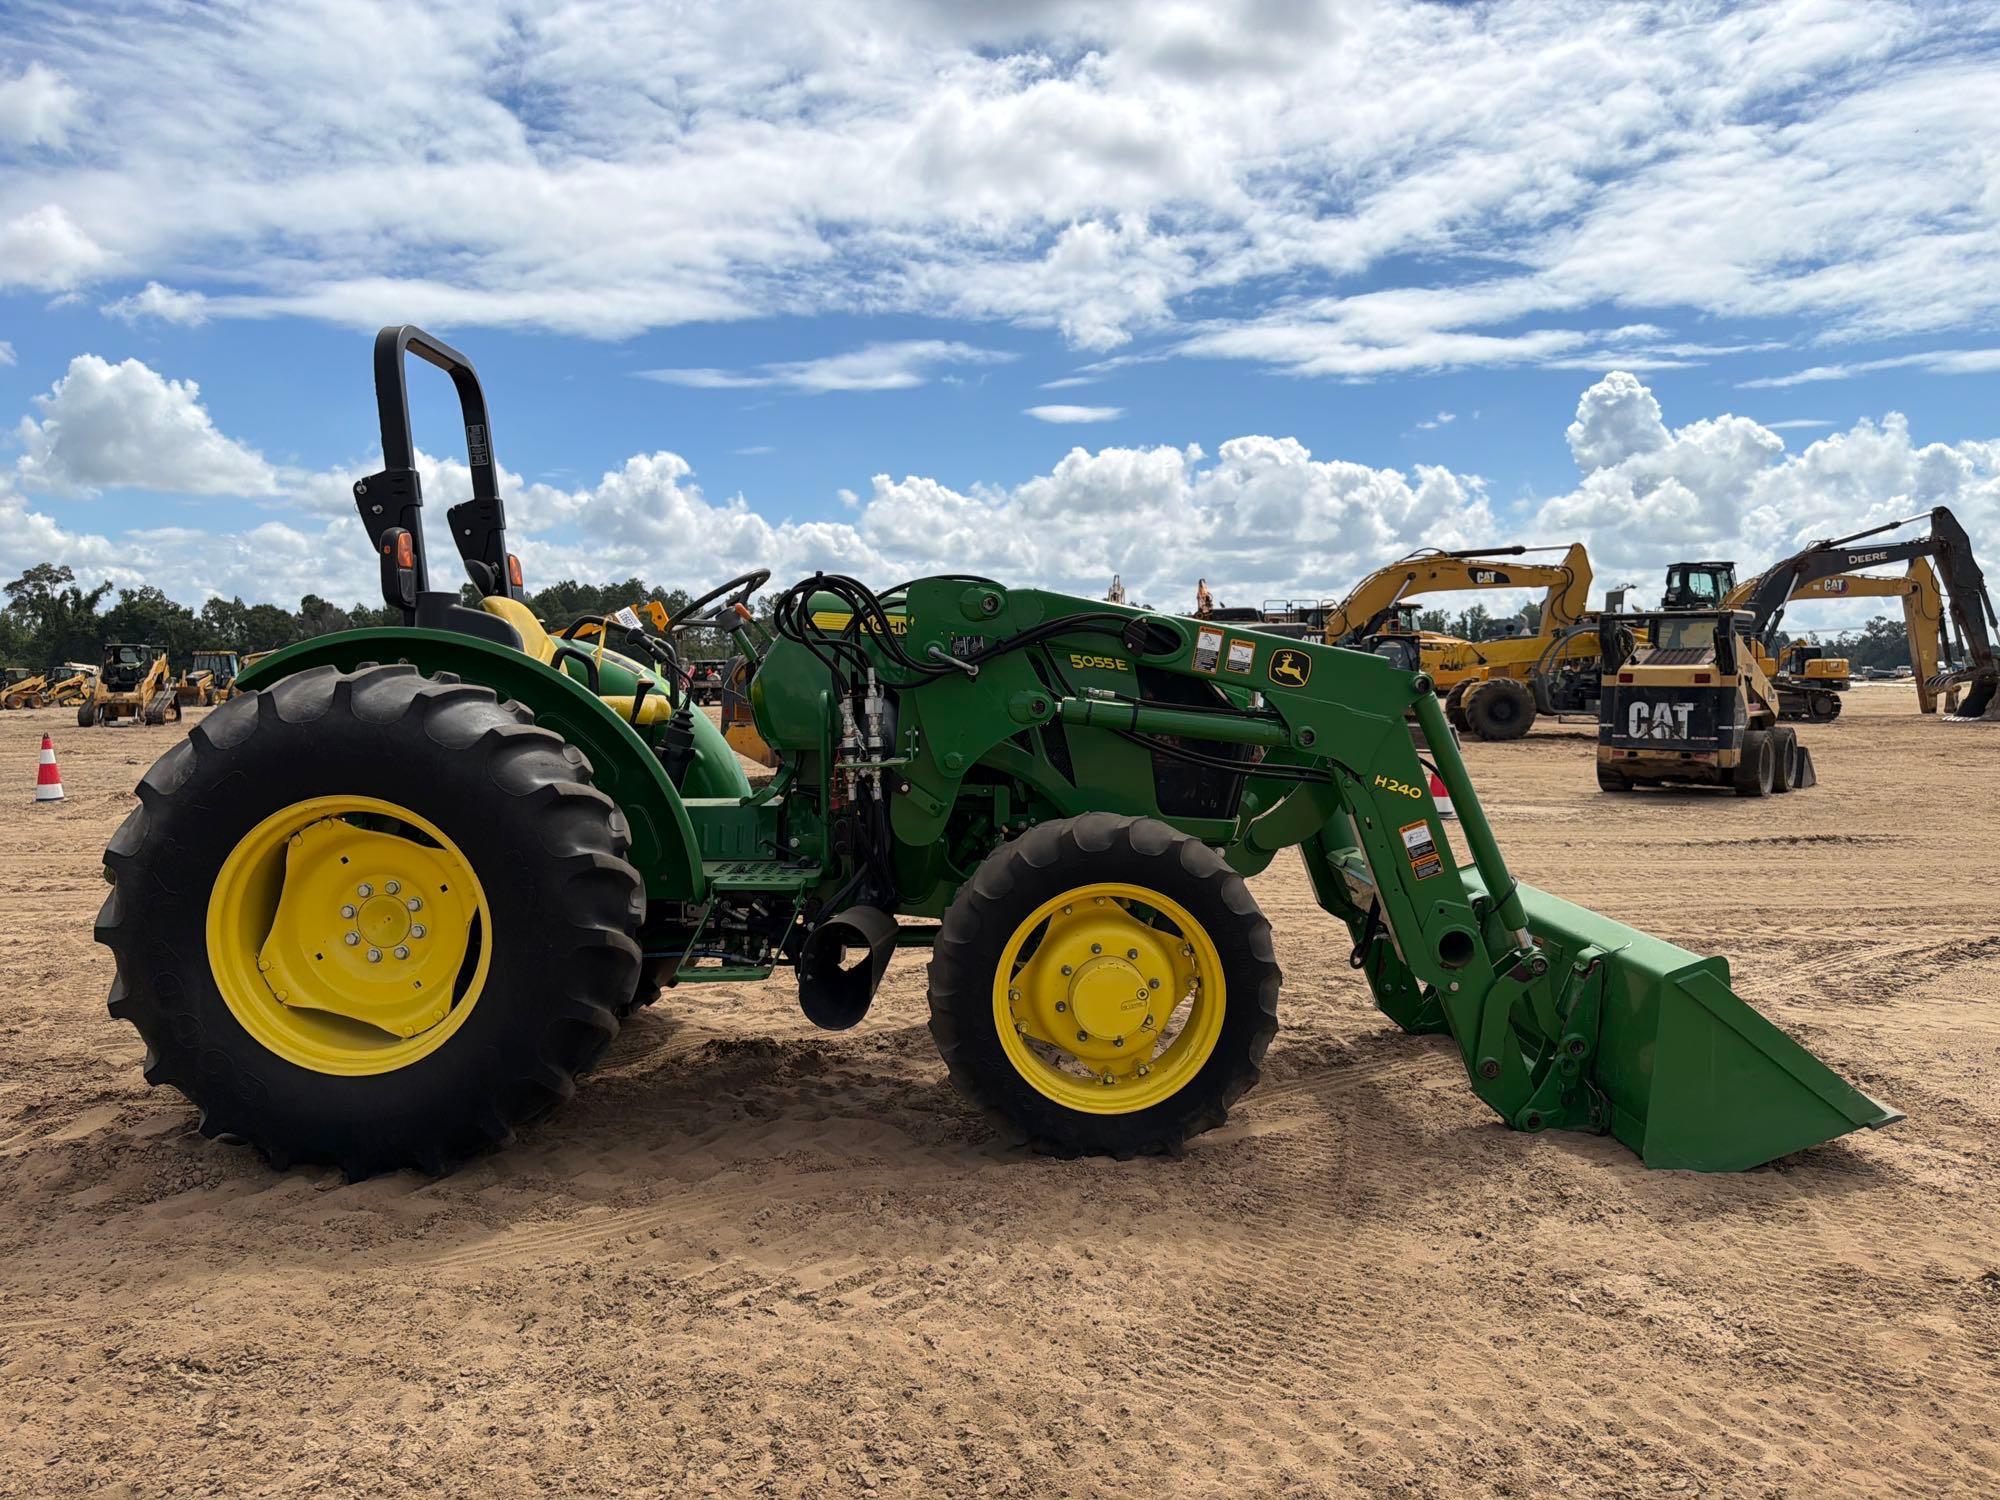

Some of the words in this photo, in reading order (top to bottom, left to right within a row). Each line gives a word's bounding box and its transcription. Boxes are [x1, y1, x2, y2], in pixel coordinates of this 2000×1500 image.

[1848, 551, 1888, 565] DEERE
[1476, 571, 1496, 584] CAT
[1824, 579, 1844, 592] CAT
[1070, 654, 1128, 671] 5055E
[1628, 701, 1694, 740] CAT
[1374, 774, 1422, 798] H240
